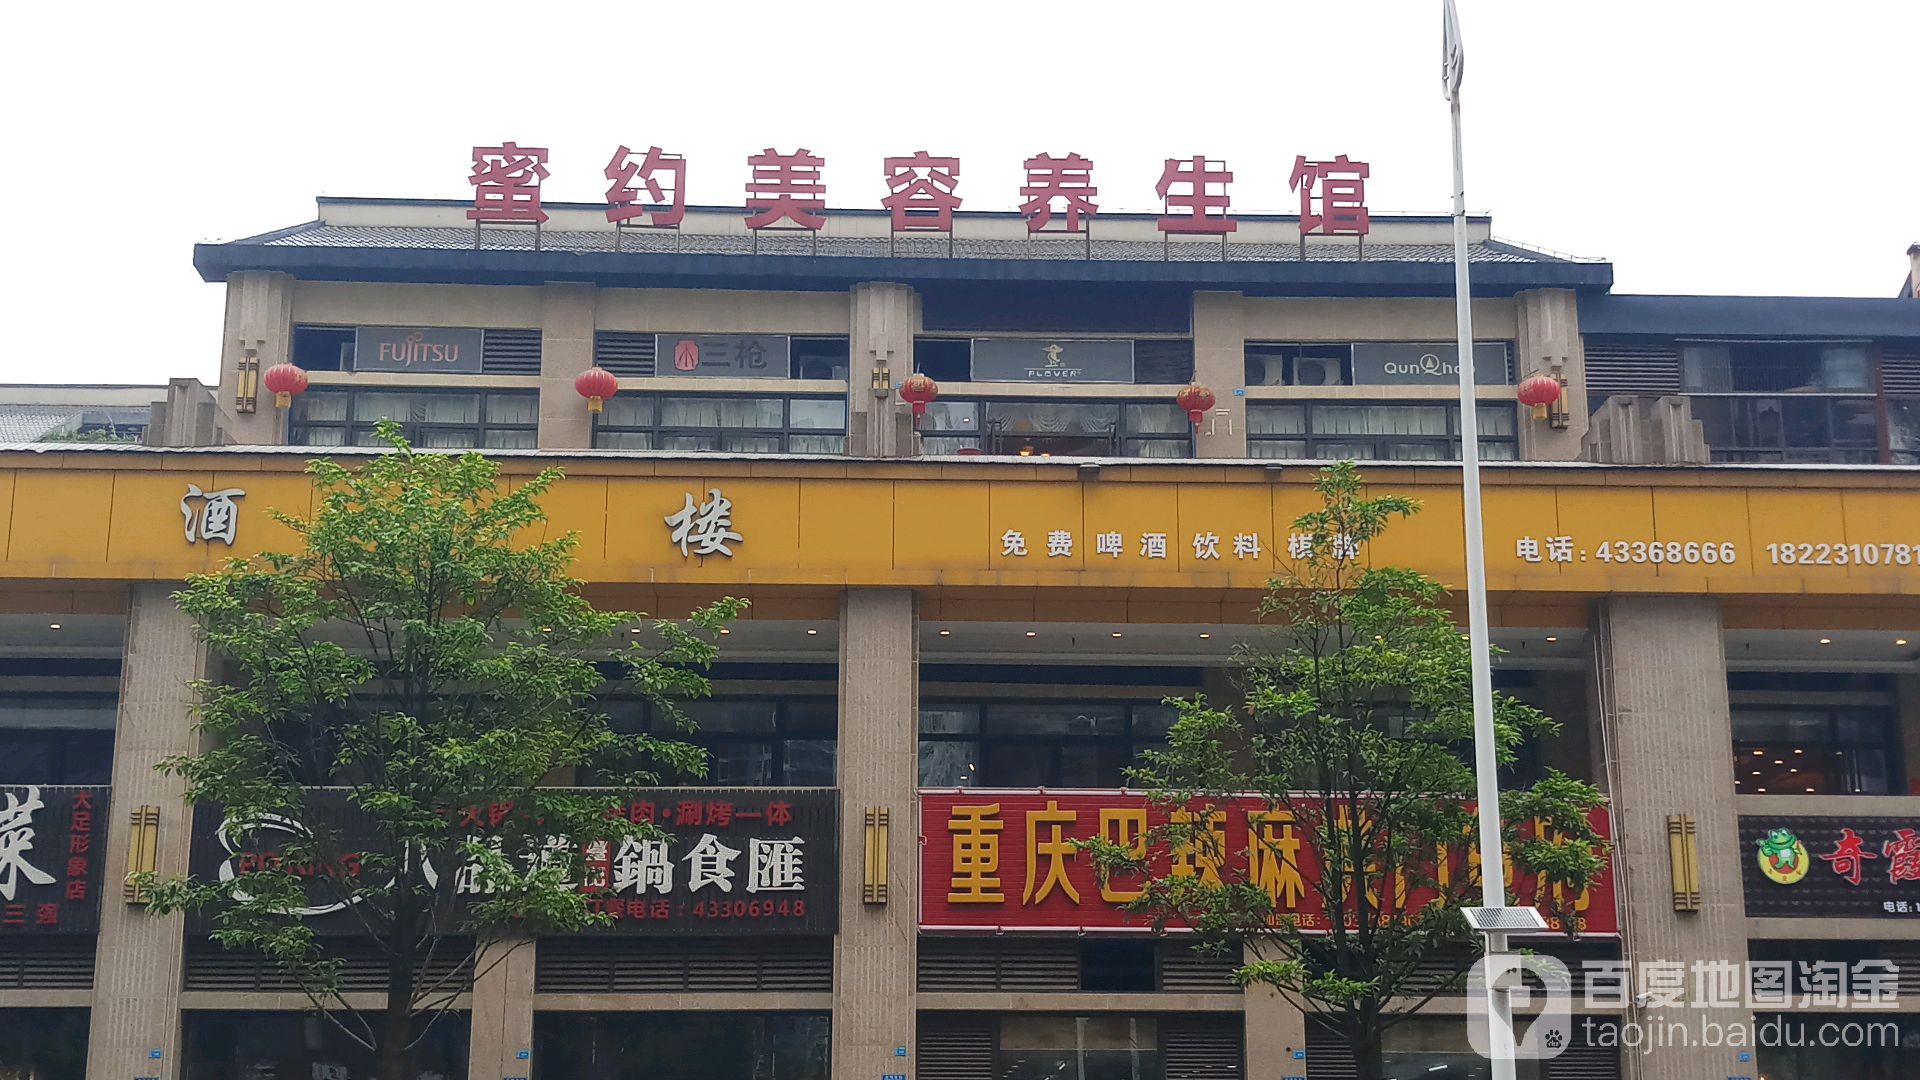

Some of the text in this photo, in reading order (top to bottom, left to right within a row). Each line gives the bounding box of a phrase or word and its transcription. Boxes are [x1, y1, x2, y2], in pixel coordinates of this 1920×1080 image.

[467, 140, 1370, 236] 蜜约美容养生馆
[379, 331, 459, 367] FUJITSU
[702, 340, 767, 369] 三枪
[1028, 369, 1077, 378] PLOVER
[180, 484, 247, 546] 酒
[663, 487, 744, 558] 楼
[65, 790, 93, 900] 大足形象店
